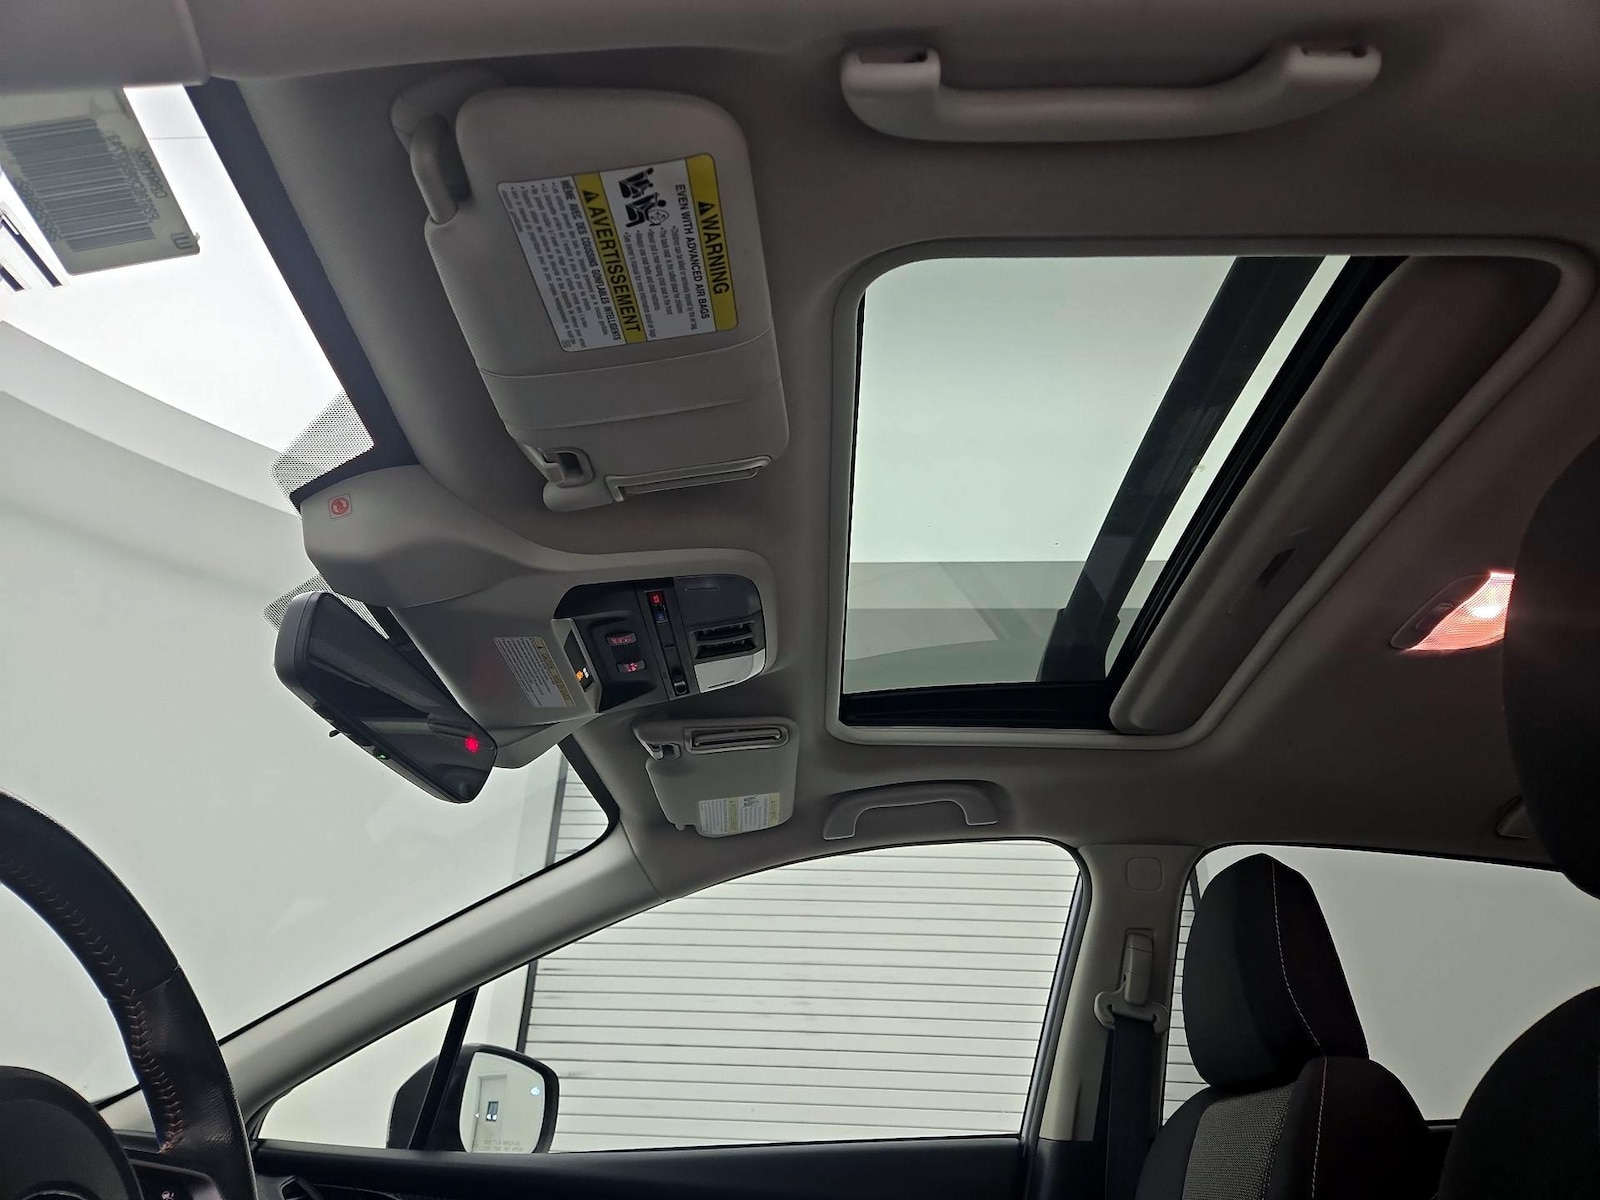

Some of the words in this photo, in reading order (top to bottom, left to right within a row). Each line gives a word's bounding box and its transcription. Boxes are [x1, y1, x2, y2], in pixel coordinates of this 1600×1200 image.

[675, 183, 689, 210] EVEN
[575, 221, 587, 234] DES
[680, 211, 694, 234] WITH
[580, 237, 598, 266] COUSSINS
[685, 236, 702, 282] ADVANCED
[701, 214, 729, 294] WARNING
[587, 205, 640, 333] AVERTISSEMENT
[695, 283, 705, 296] AIR
[698, 298, 710, 319] BAGS
